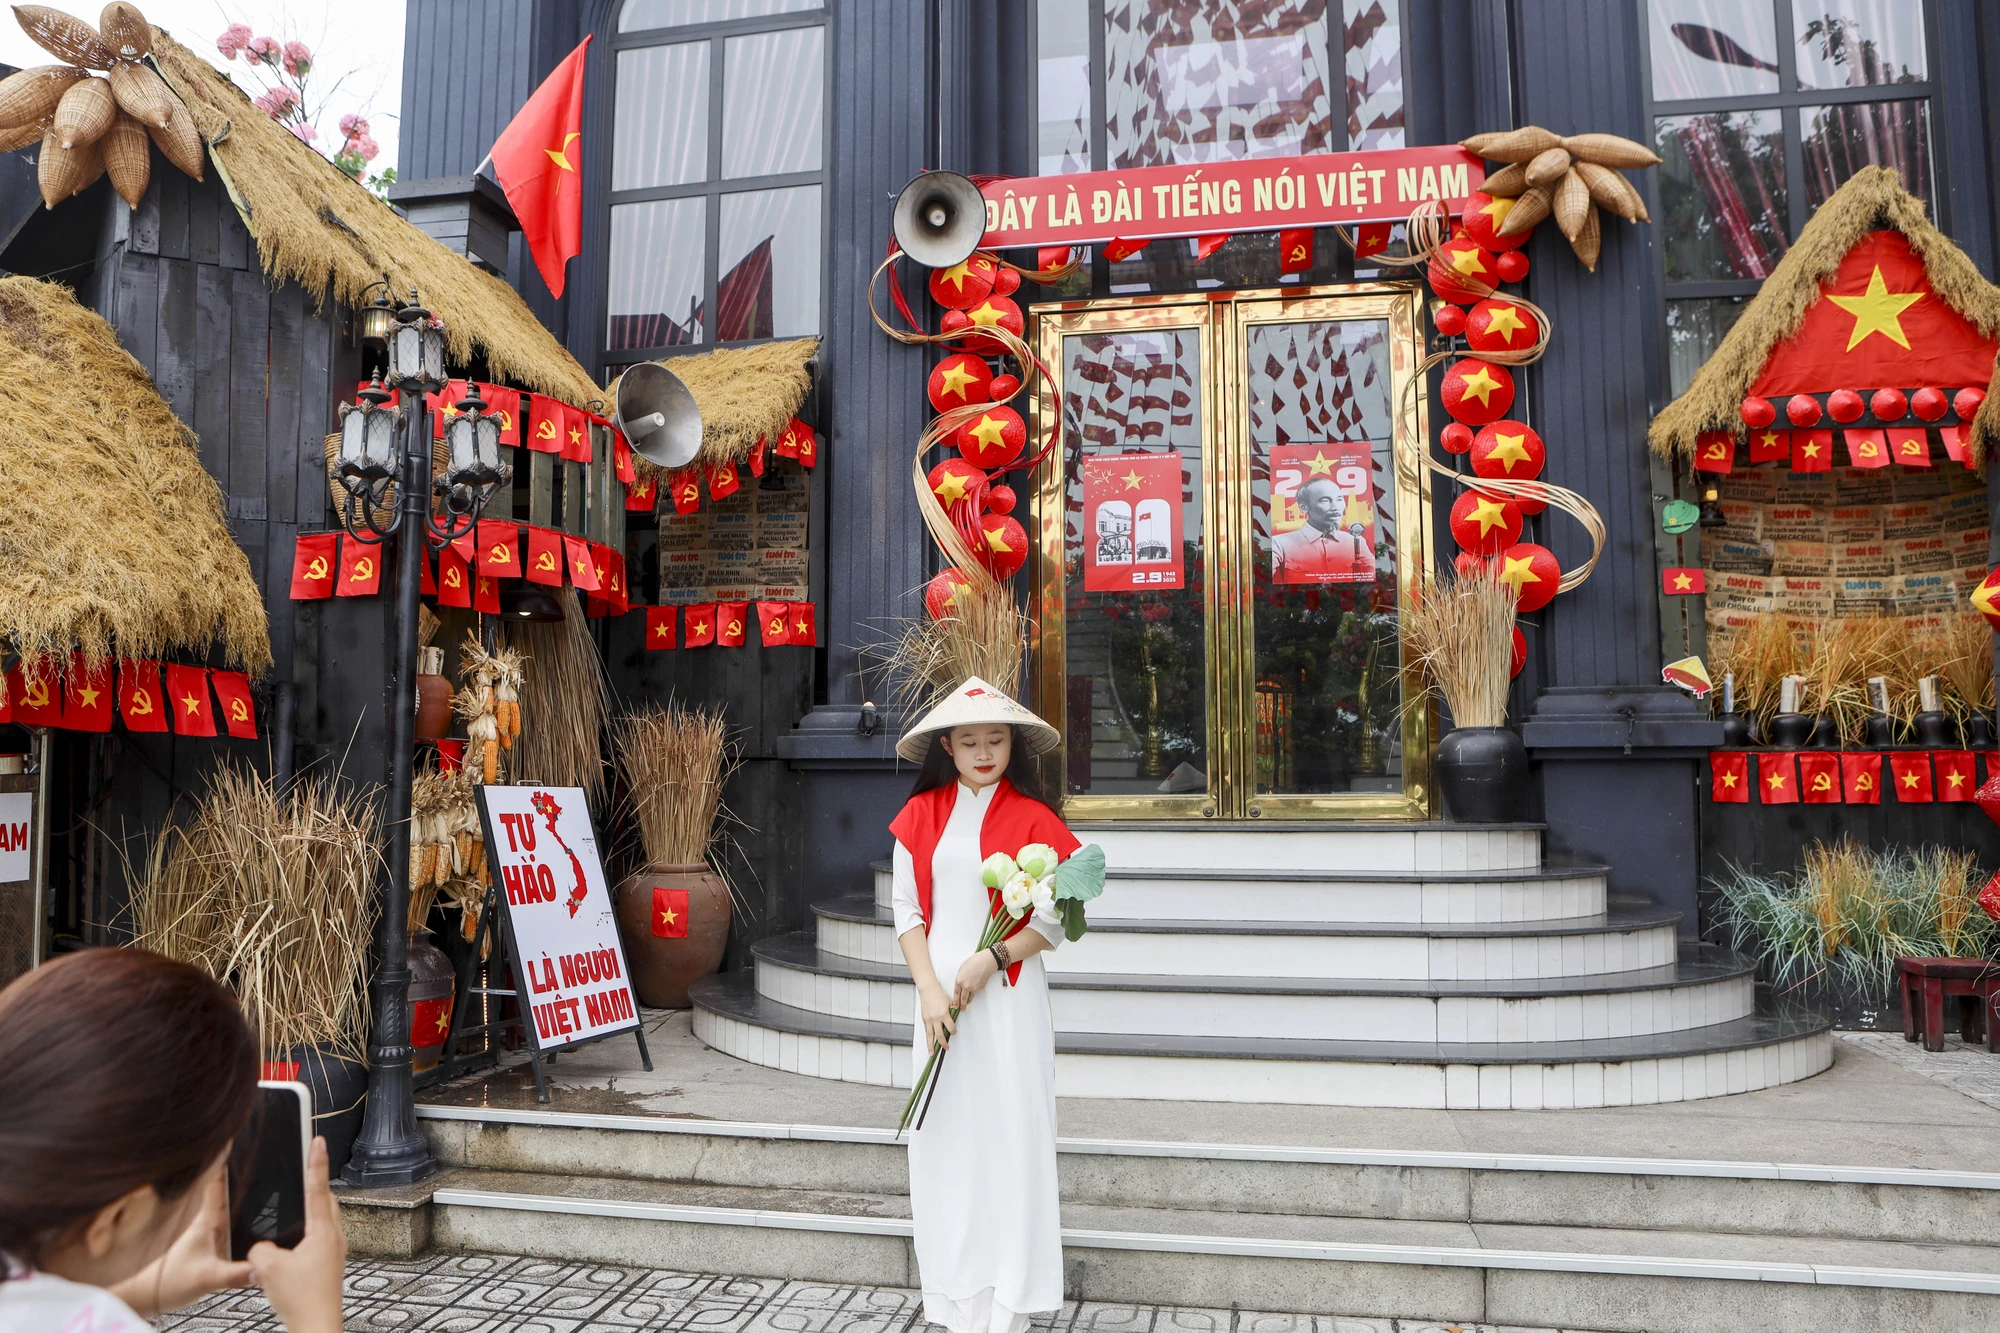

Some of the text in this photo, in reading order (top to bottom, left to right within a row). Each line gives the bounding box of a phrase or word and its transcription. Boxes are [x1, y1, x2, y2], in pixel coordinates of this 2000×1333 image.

[985, 163, 1468, 232] ĐÂY LÀ ĐÀI TIẾNG NÓI VIỆT NAM
[1336, 466, 1368, 496] 9
[1132, 571, 1162, 584] 2.9
[500, 813, 536, 863] TỰ
[503, 856, 556, 906] HÀO
[527, 951, 560, 994] LÀ
[559, 943, 621, 988] NGƯỜI
[533, 993, 582, 1043] VIỆT
[584, 988, 634, 1028] NAM
